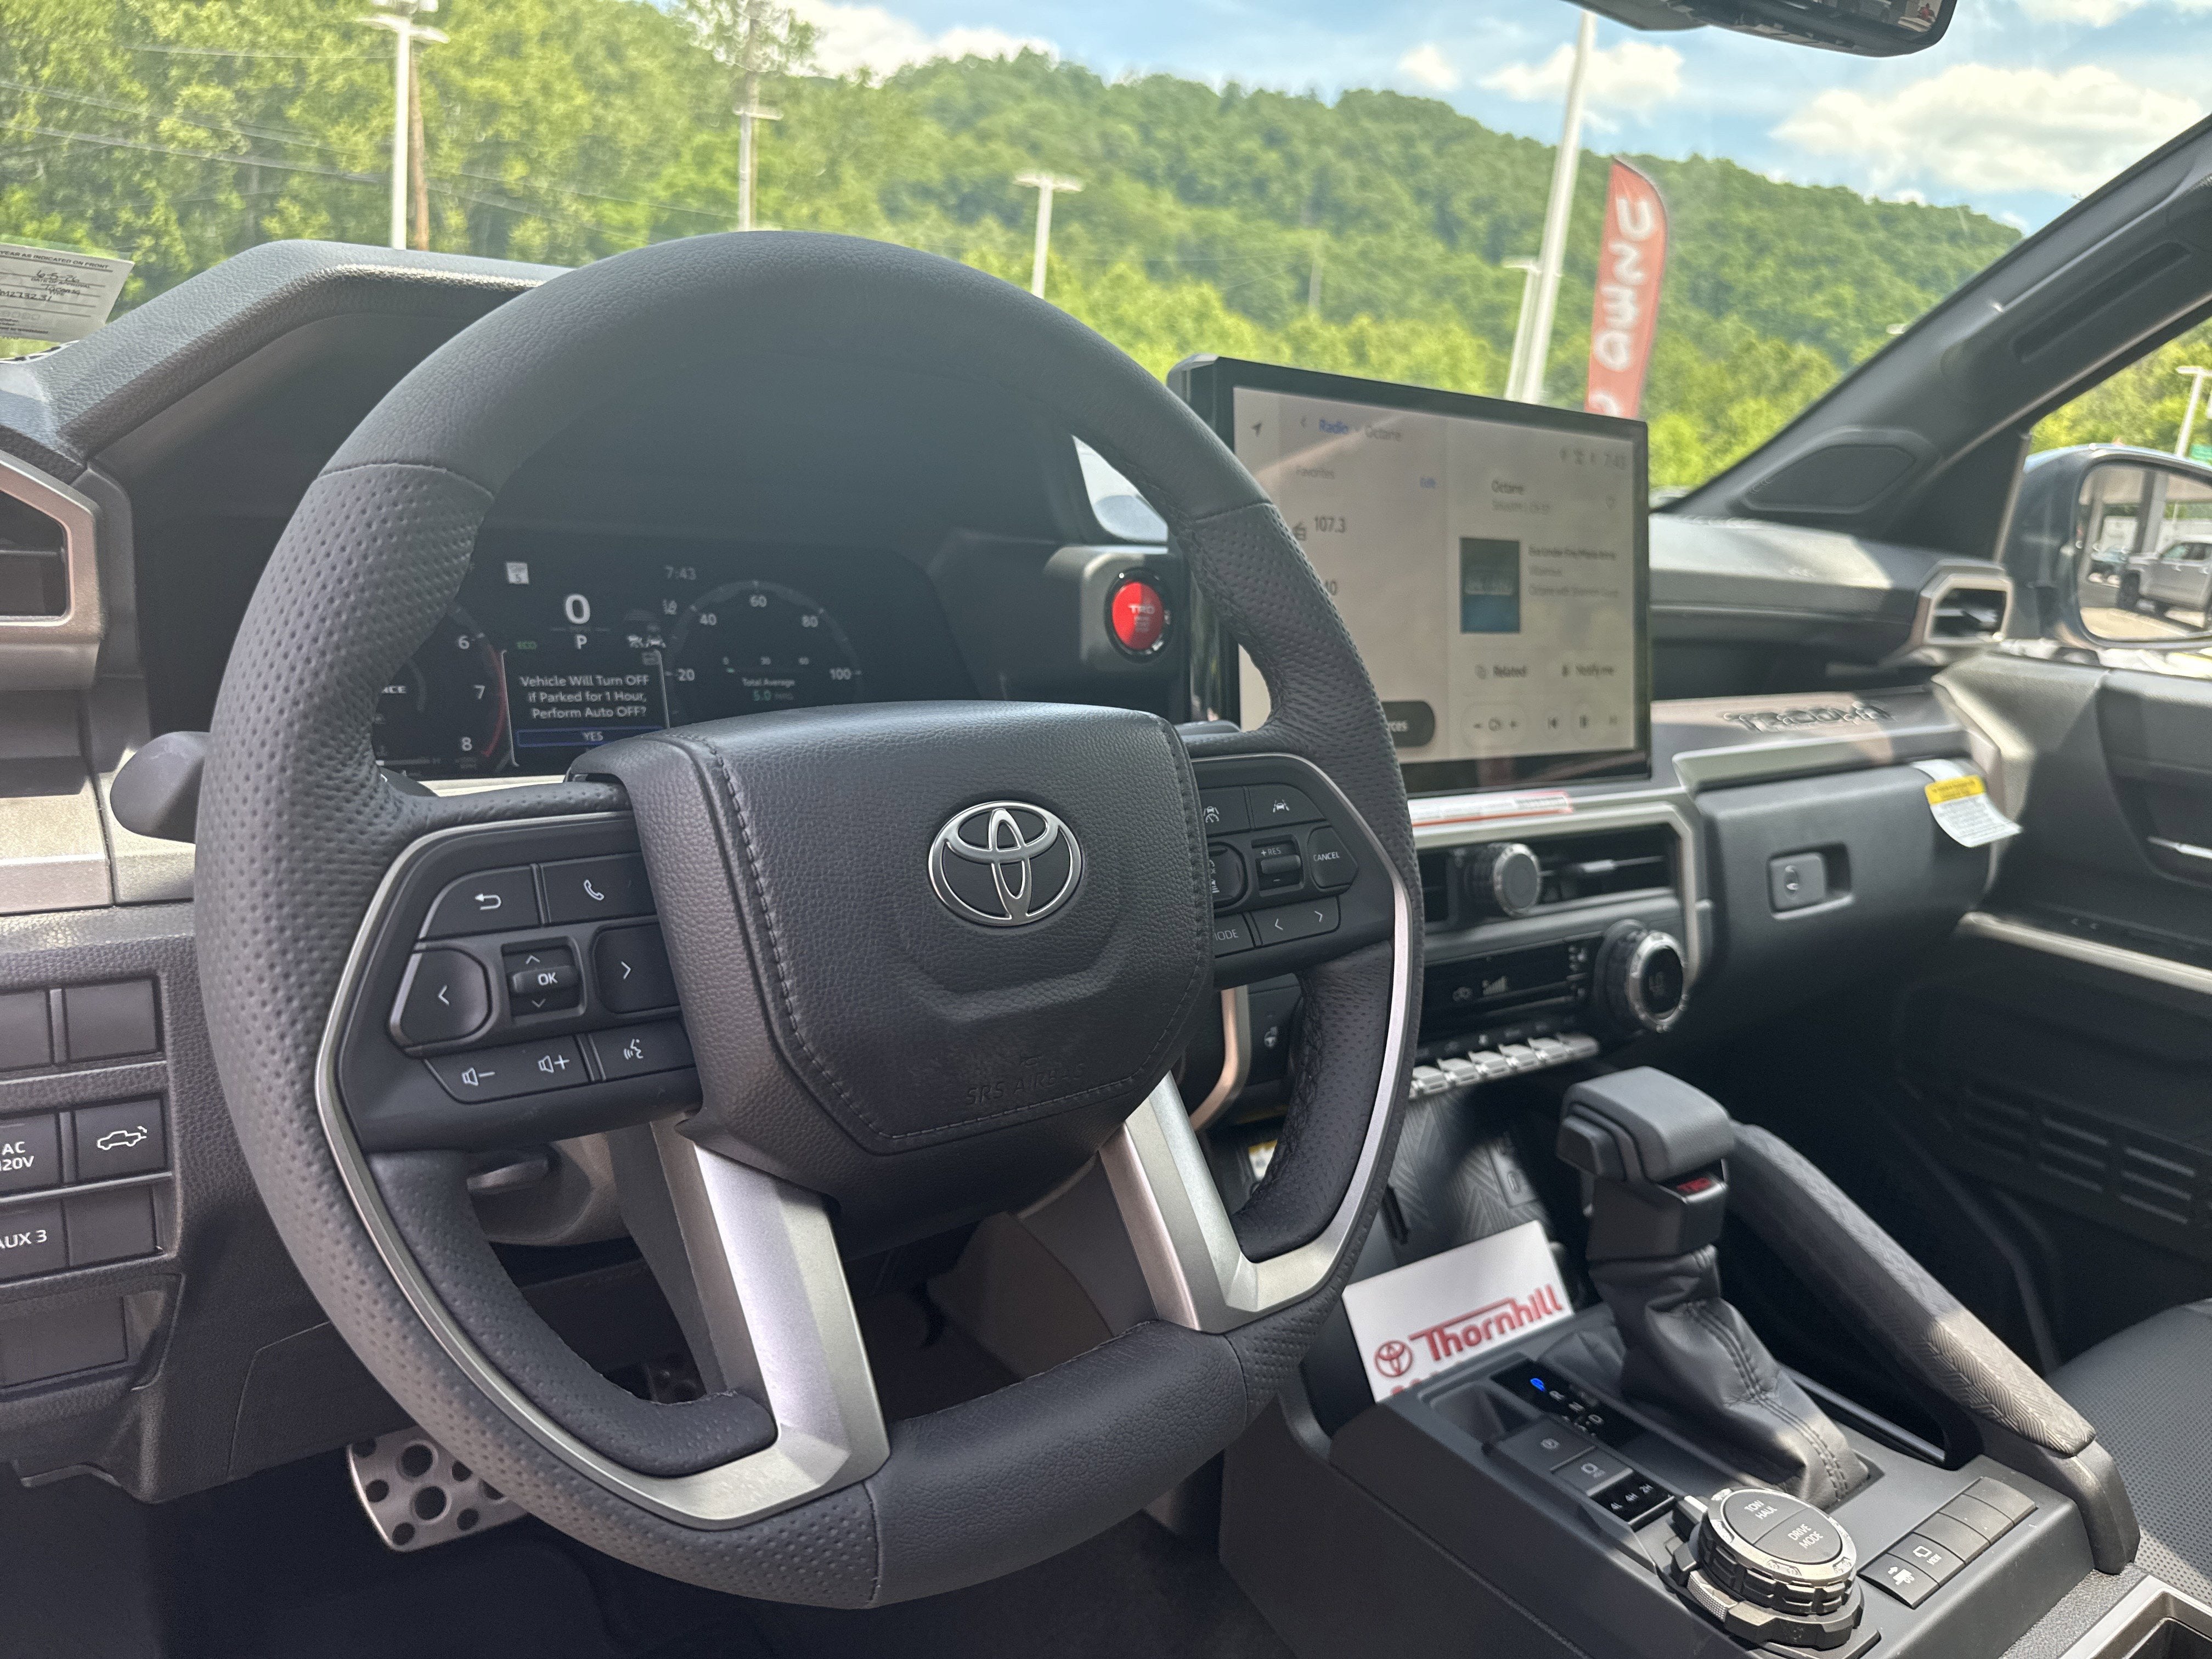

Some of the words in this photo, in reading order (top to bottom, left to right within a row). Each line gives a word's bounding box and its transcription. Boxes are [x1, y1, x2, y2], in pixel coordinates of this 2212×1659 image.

[33, 255, 71, 263] INDICATED
[1314, 516, 1346, 534] 107.3
[665, 566, 697, 581] 7:43
[563, 593, 591, 624] 0
[749, 595, 768, 608] 60
[699, 614, 717, 626] 40
[802, 616, 819, 628] 80
[458, 635, 470, 650] 6
[574, 634, 588, 650] P
[520, 675, 566, 687] Vehicle
[569, 675, 593, 687] Will
[596, 675, 623, 687] Turn
[625, 674, 650, 686] OFF
[677, 669, 695, 681] 20
[830, 668, 852, 680] 100
[768, 678, 795, 689] Average
[473, 685, 486, 699] 7
[540, 691, 583, 703] Parked
[585, 691, 603, 702] for
[605, 691, 611, 702] 1
[531, 707, 582, 720] Perform
[585, 707, 614, 718] Auto
[617, 706, 647, 718] OFF?
[461, 737, 473, 751] 8
[582, 732, 603, 742] YES
[1313, 851, 1340, 862] CANCEL
[537, 972, 558, 986] OK
[2, 1141, 26, 1155] AC
[36, 1229, 47, 1243] 3
[1408, 1283, 1563, 1362] Thornhill
[1744, 1499, 1765, 1514] TOW
[1754, 1506, 1778, 1520] HAUL
[1787, 1522, 1812, 1542] DRIVE
[1798, 1531, 1824, 1550] MODE
